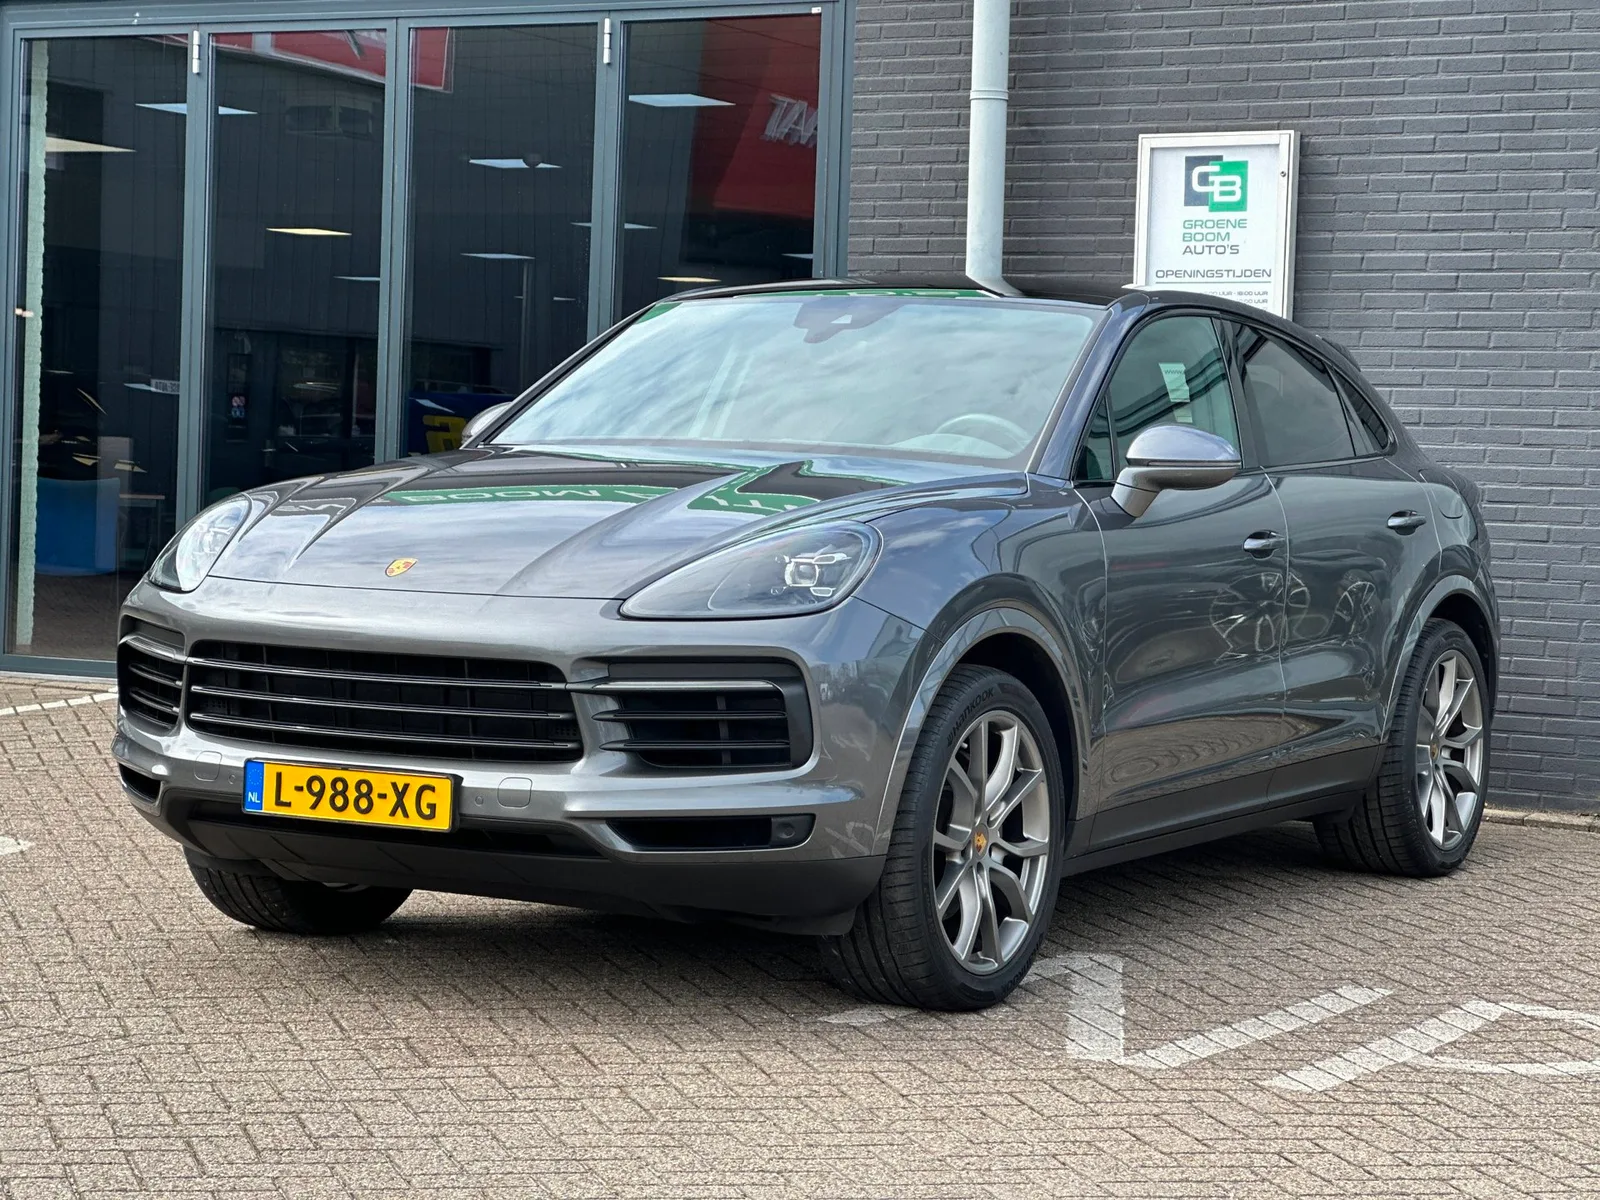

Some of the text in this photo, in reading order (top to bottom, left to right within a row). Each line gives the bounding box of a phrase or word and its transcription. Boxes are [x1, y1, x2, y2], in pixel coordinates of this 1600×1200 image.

[1183, 218, 1247, 229] GROENE
[1182, 231, 1230, 242] BOOM
[1182, 244, 1240, 255] AUTO'S
[1155, 268, 1272, 279] OPENINGSTIJDEN
[247, 791, 261, 803] NL
[274, 771, 437, 820] L-988-XG
